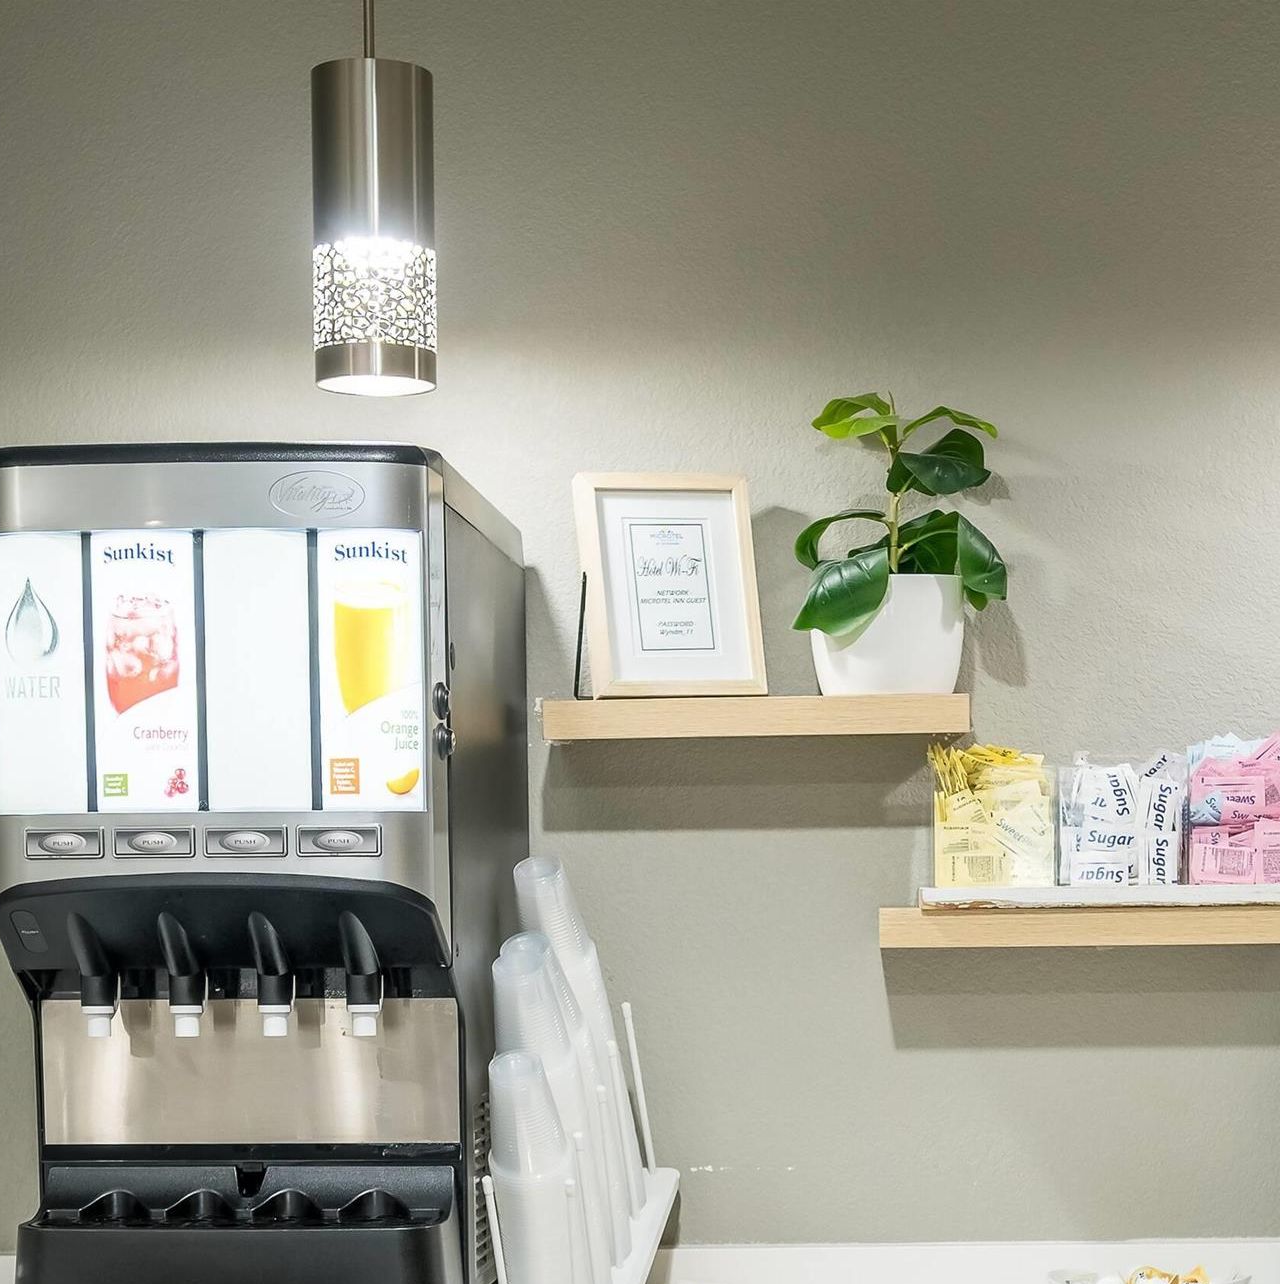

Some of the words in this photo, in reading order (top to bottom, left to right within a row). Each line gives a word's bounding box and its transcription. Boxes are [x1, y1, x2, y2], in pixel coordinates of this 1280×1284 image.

[103, 542, 176, 567] Sunkist
[333, 541, 408, 566] Sunkist
[5, 675, 61, 698] WATER
[133, 726, 188, 742] Cranberry
[380, 720, 419, 738] Orange
[394, 737, 419, 751] Juice
[1106, 773, 1130, 816] Sugar
[1153, 784, 1172, 831] Sugar
[1087, 830, 1135, 848] Sugar
[1153, 838, 1169, 884] Sugar
[1079, 867, 1124, 883] Sugar
